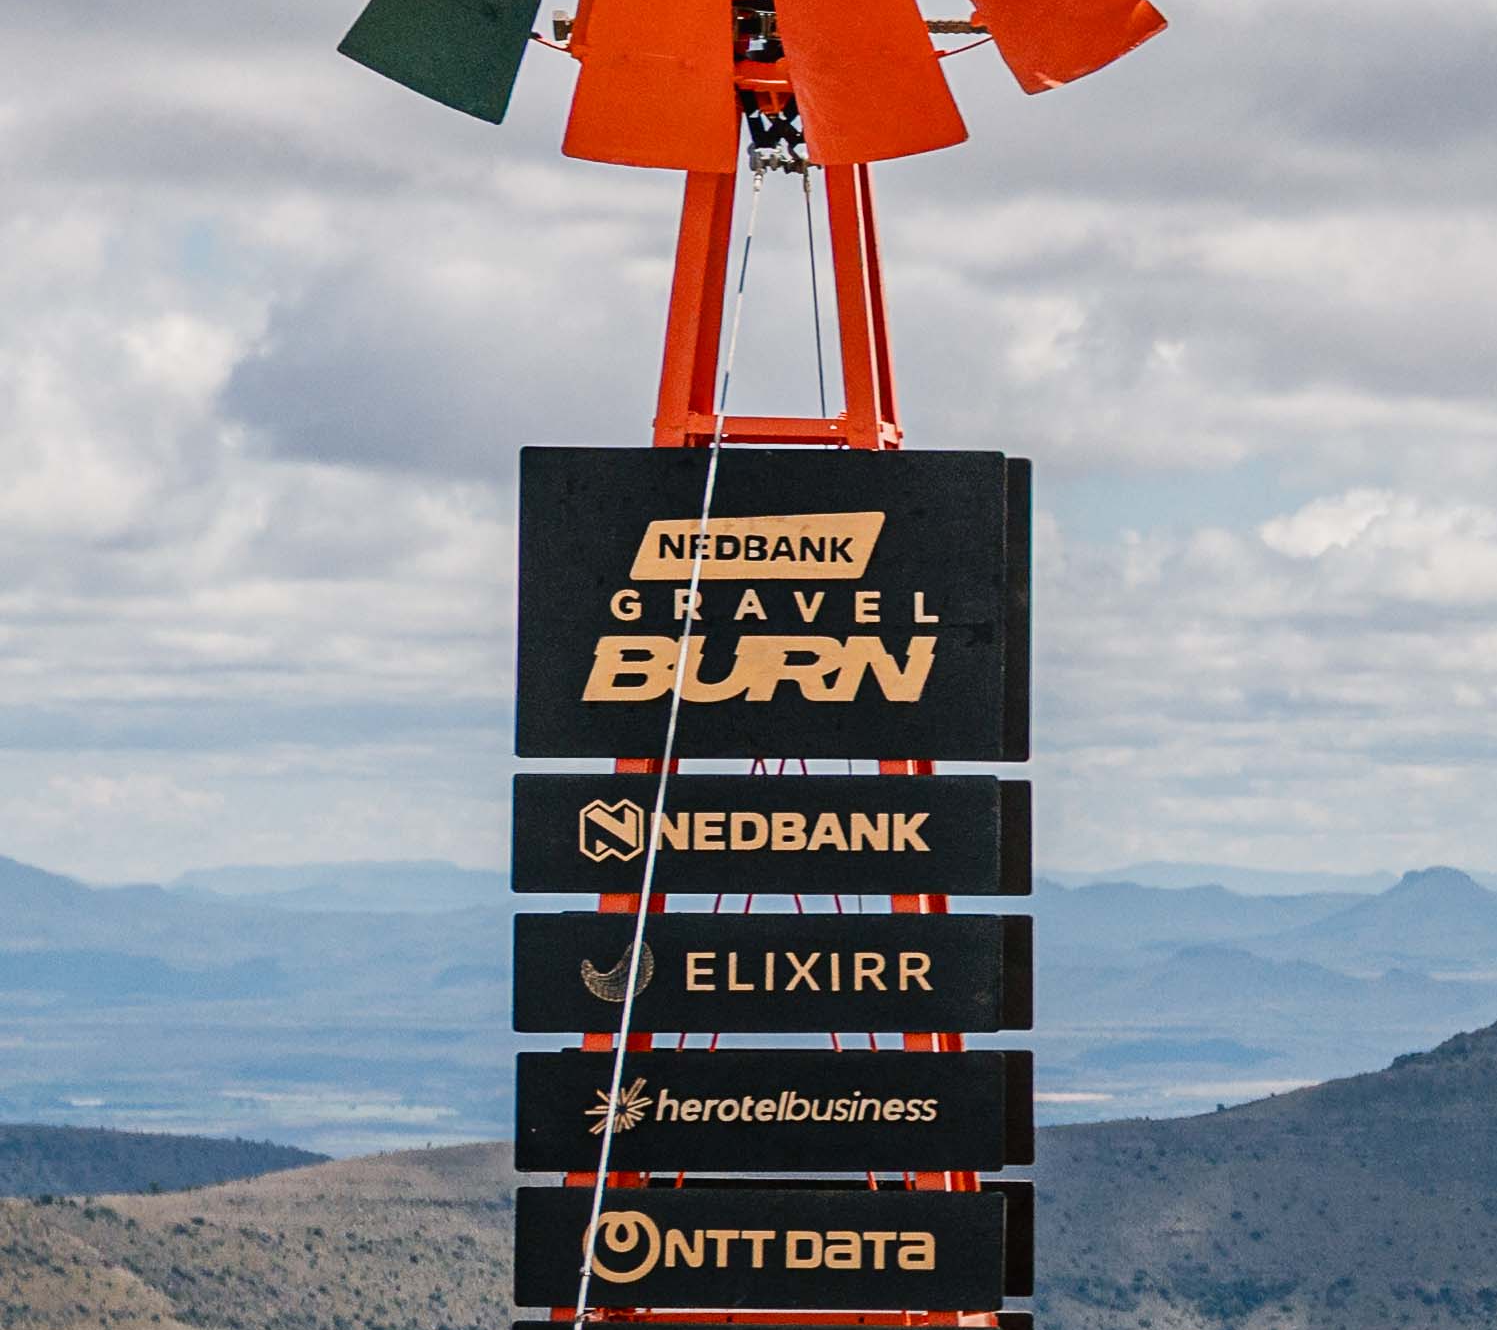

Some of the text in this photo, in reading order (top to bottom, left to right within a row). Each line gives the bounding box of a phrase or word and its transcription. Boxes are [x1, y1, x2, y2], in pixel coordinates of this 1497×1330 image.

[658, 534, 854, 563] NEDBANK
[610, 589, 939, 623] GRAVEL
[581, 636, 938, 702] BURN
[650, 812, 931, 852] NEDBANK
[685, 952, 934, 991] ELIXIRR
[655, 1089, 938, 1123] herotelbusiness
[665, 1229, 776, 1269] NTT
